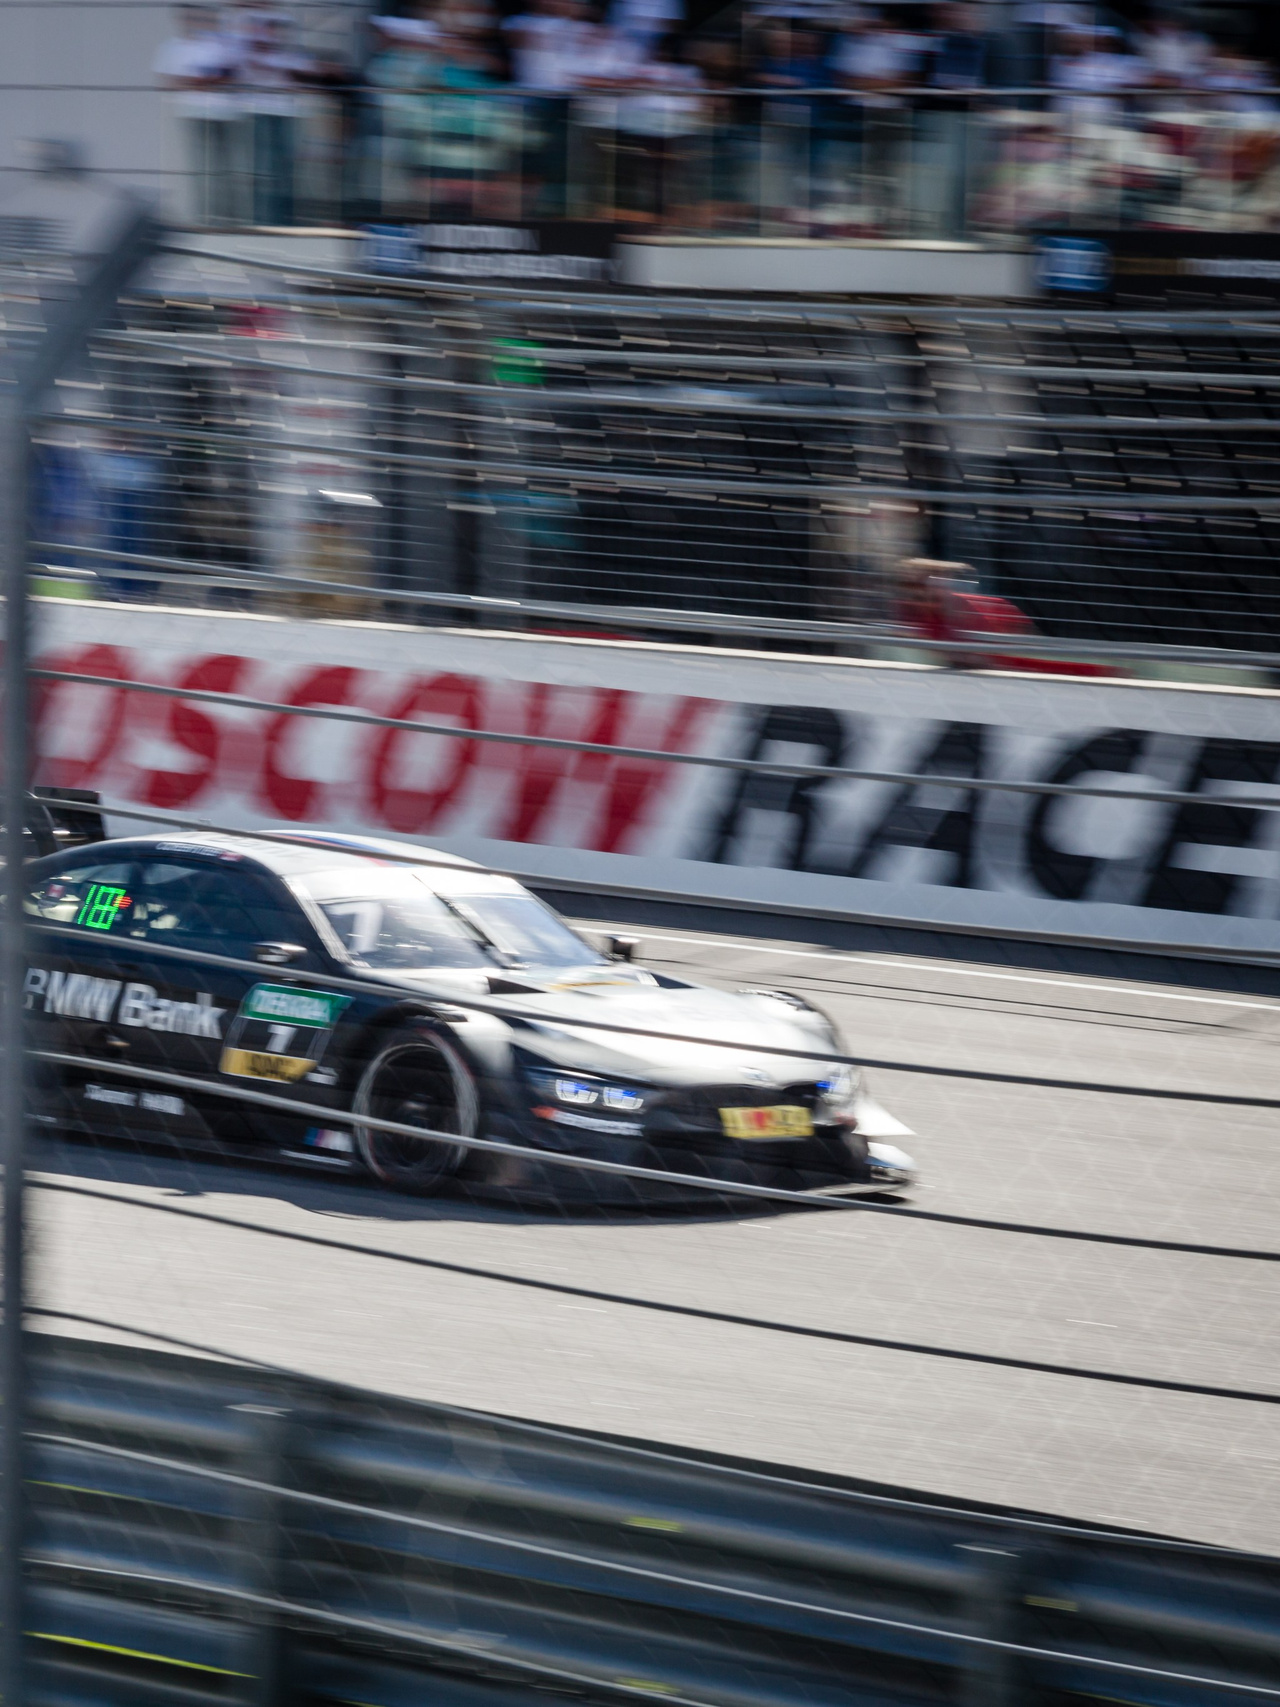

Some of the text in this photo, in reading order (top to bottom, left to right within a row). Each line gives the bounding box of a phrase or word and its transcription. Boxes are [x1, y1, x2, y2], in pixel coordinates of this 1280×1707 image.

[708, 703, 1280, 918] RACE
[77, 884, 126, 930] 18
[23, 968, 227, 1039] BMW Bank
